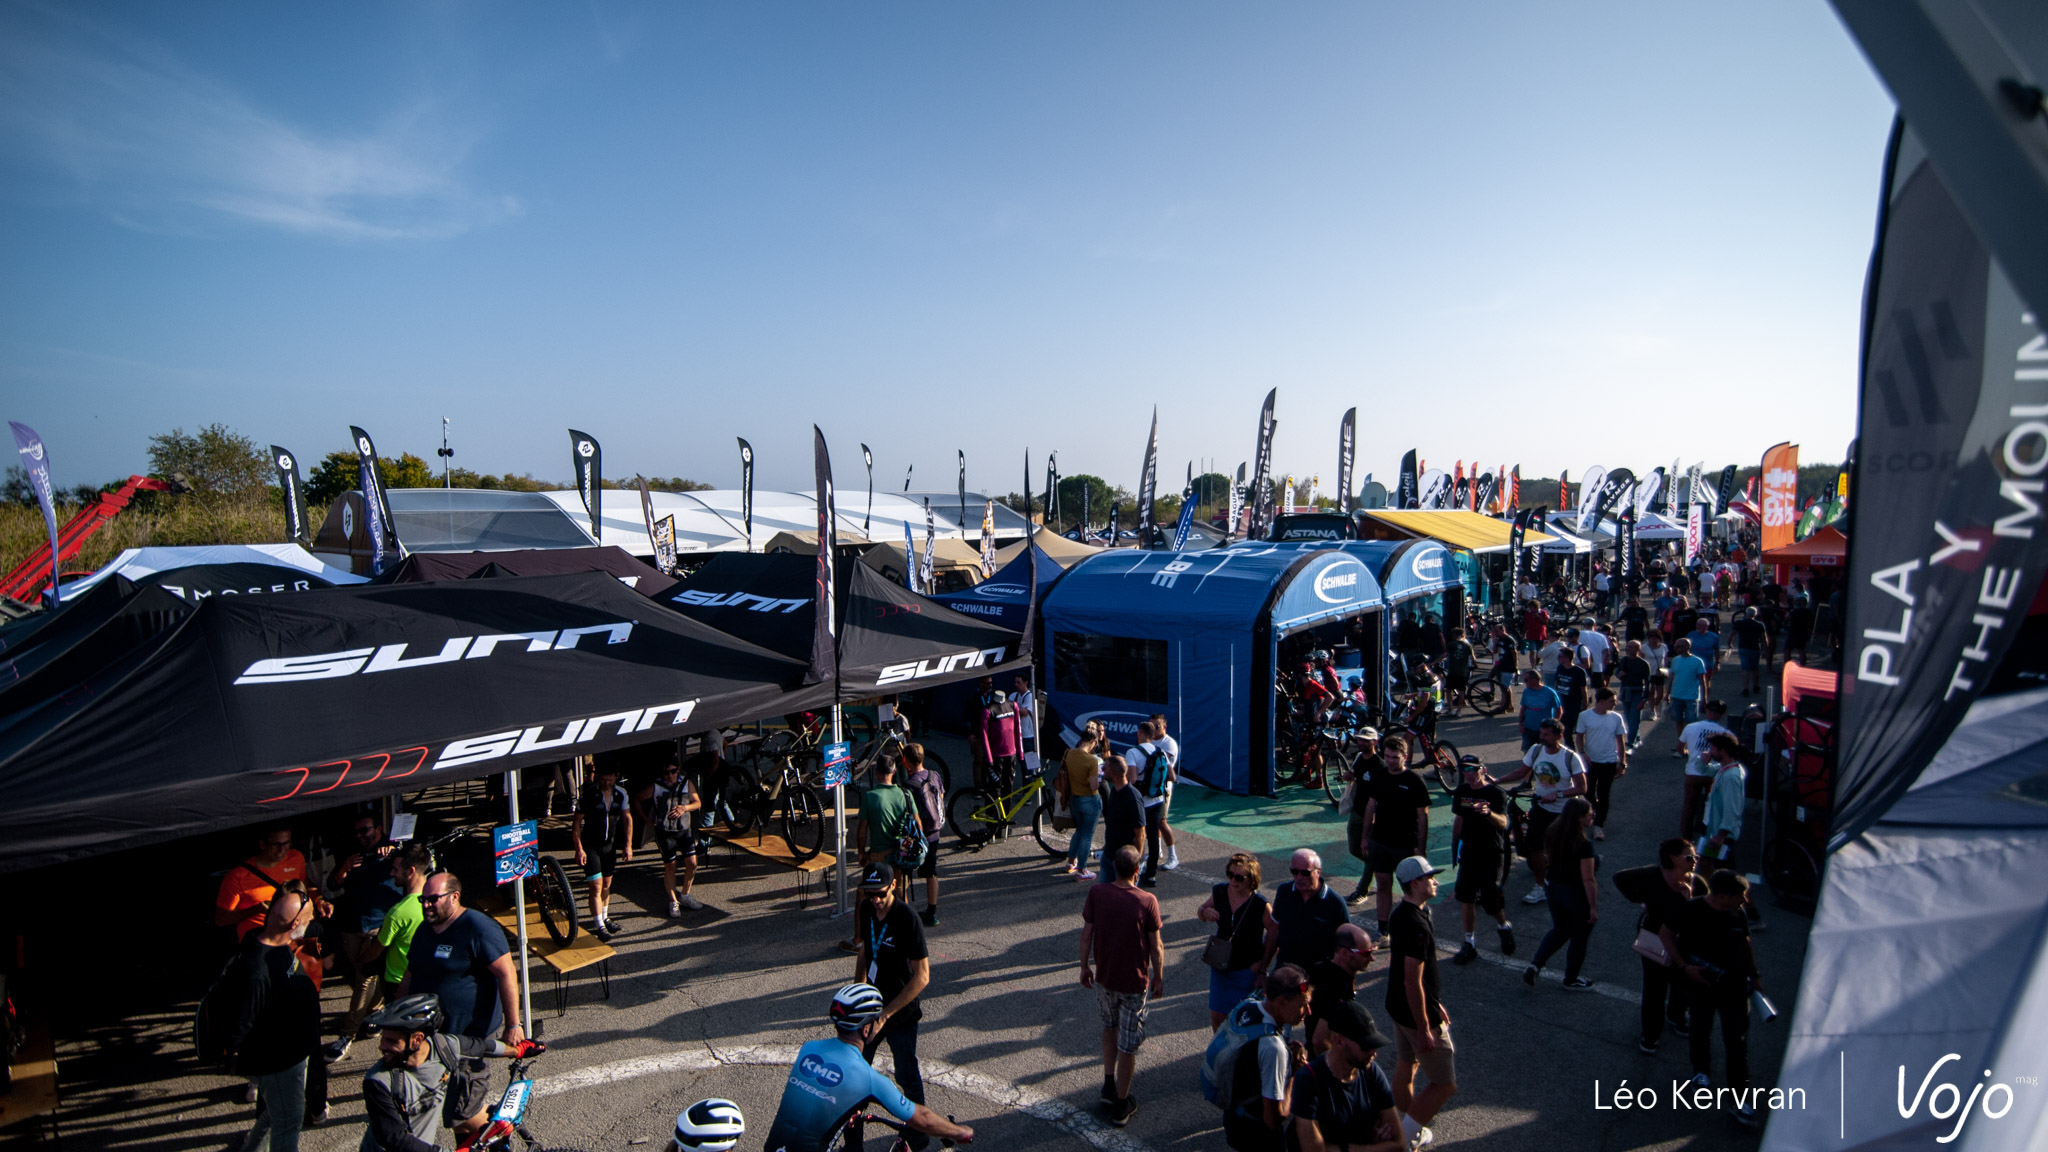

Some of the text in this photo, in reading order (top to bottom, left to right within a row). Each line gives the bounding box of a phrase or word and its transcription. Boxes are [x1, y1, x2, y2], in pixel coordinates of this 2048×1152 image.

[1602, 477, 1630, 511] RAYMON
[1282, 529, 1339, 540] ASTANA
[1418, 557, 1444, 571] SCHWALBE
[983, 586, 1026, 595] SCHWALBE
[1321, 572, 1357, 590] SCHWALBE
[951, 602, 1004, 616] SCHWALBE
[1857, 520, 1981, 686] PLAY
[1943, 565, 2022, 701] THE
[801, 1058, 841, 1083] KMC
[502, 1088, 519, 1110] 37735
[789, 1076, 837, 1105] ORBEA
